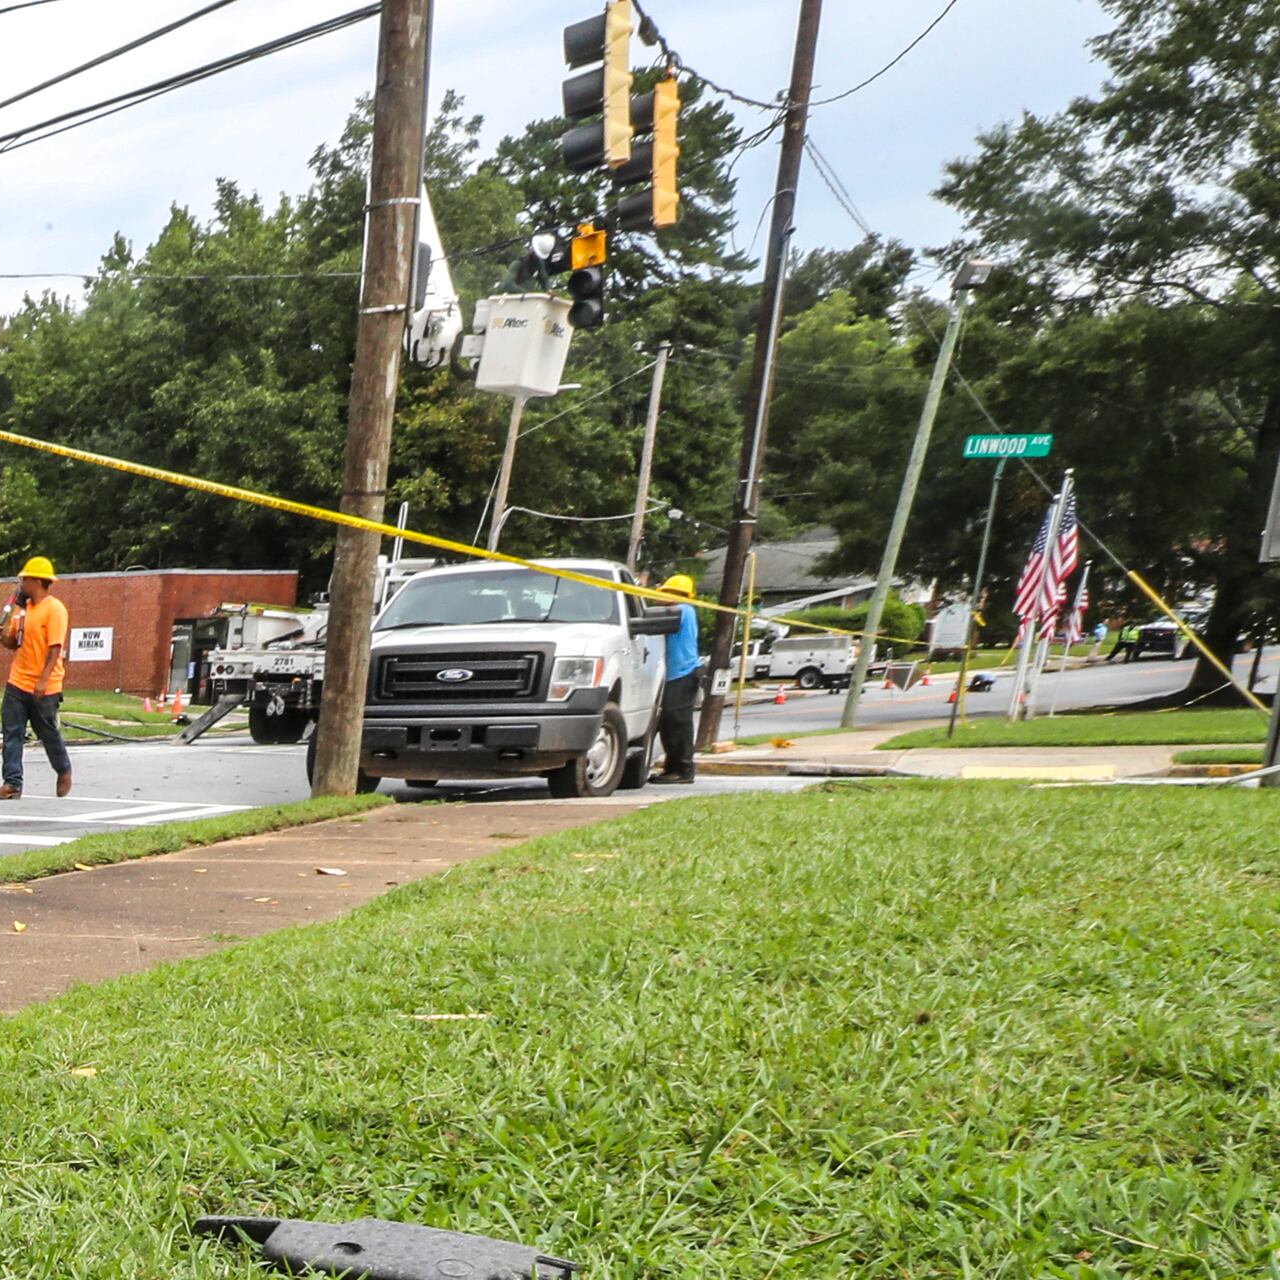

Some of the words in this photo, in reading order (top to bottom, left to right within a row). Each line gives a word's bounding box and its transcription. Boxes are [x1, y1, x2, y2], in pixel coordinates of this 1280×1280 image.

[966, 437, 1027, 455] LINWOOD
[1031, 434, 1052, 445] AVE
[83, 631, 101, 640] NOW
[78, 640, 104, 649] HIRING
